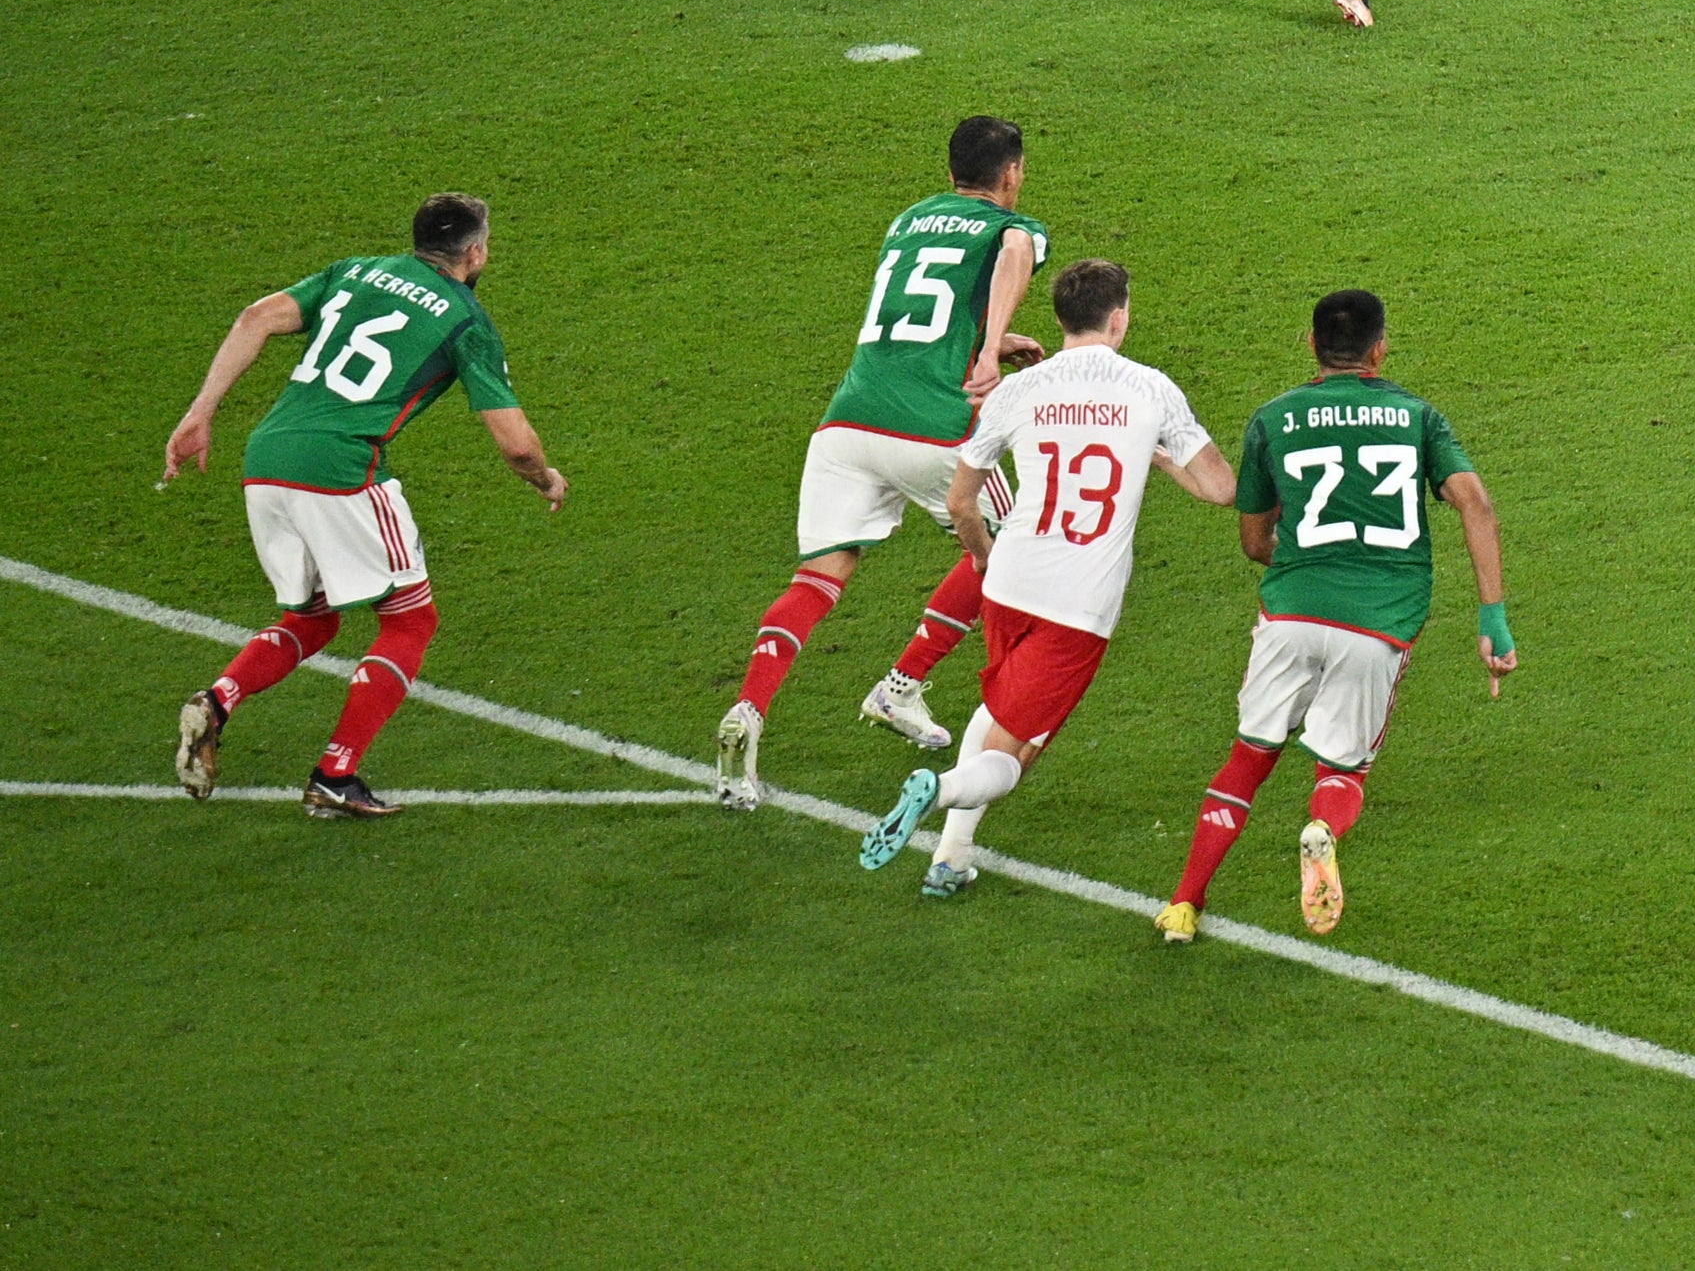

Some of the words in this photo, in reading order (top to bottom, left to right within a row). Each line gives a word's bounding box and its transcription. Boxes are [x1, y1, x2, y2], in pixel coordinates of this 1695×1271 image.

[910, 214, 987, 236] MORENO
[362, 266, 451, 318] HERRERA
[857, 247, 966, 344] 15
[290, 289, 410, 403] 16
[1033, 399, 1129, 428] KAMIŃSKI
[1282, 412, 1301, 434] J.
[1307, 405, 1411, 428] GALLARDO
[1035, 441, 1123, 545] 13
[1283, 444, 1421, 550] 23
